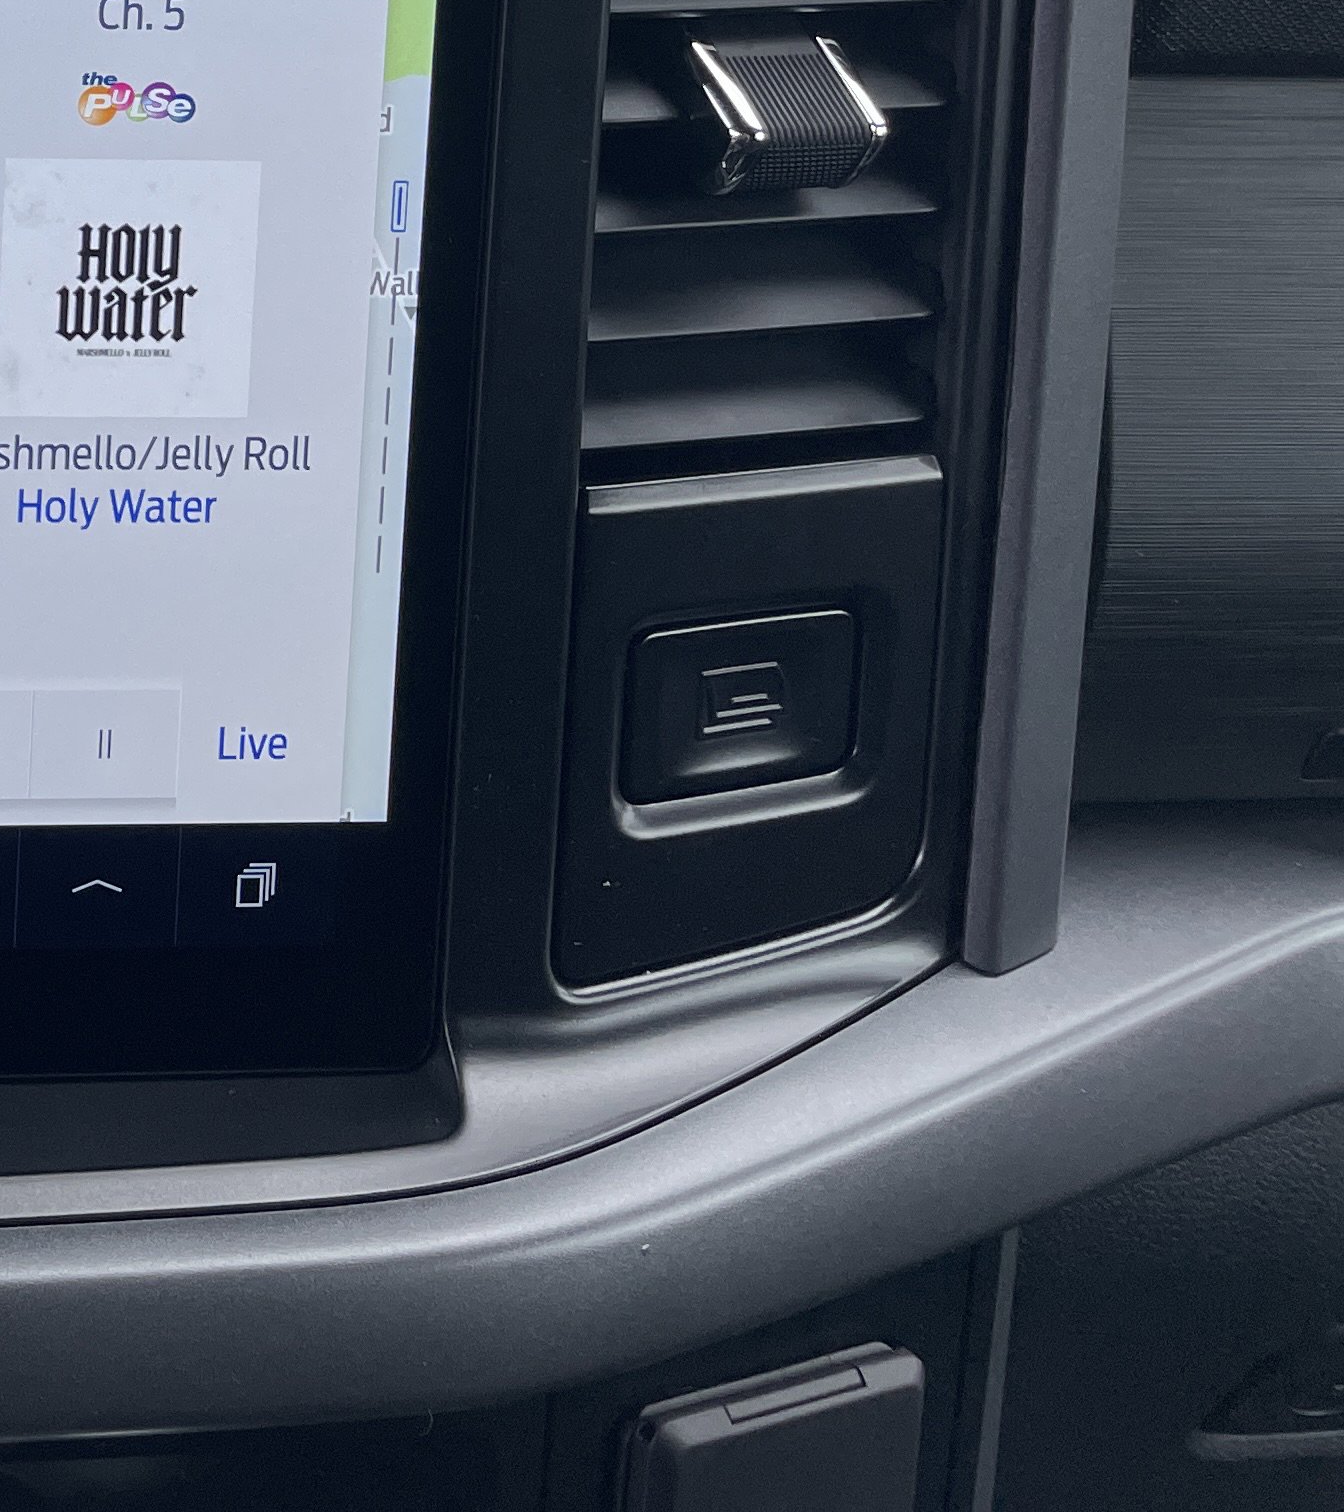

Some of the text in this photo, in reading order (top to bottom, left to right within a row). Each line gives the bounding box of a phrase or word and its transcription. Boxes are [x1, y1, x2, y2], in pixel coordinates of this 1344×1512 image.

[81, 71, 118, 86] the
[244, 436, 311, 471] Roll
[17, 488, 216, 529] Holy Water
[217, 726, 288, 762] Live
